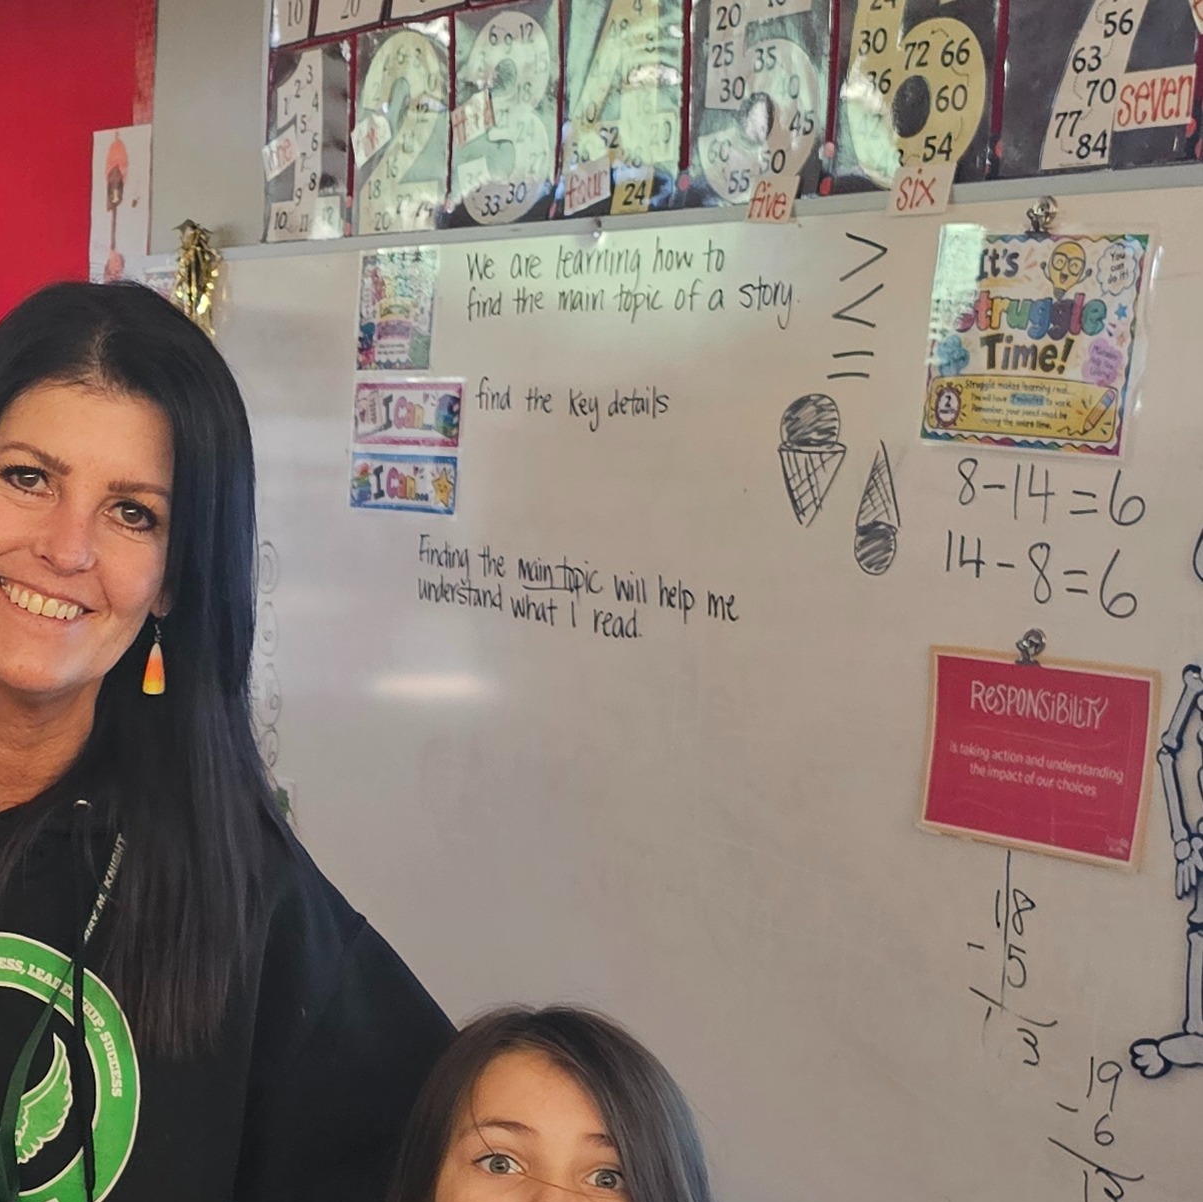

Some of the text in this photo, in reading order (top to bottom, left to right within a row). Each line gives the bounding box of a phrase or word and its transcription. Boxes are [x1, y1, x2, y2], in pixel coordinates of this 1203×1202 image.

[716, 3, 742, 30] 20
[1103, 8, 1133, 39] 56
[712, 41, 734, 68] 25
[858, 27, 887, 56] 30
[904, 41, 930, 70] 72
[941, 38, 970, 68] 66
[753, 46, 777, 73] 35
[1072, 45, 1102, 74] 63
[720, 76, 746, 103] 30
[935, 84, 968, 113] 60
[1086, 78, 1117, 107] 70
[1117, 75, 1193, 127] seven
[789, 111, 814, 135] 45
[1055, 110, 1082, 138] 77
[922, 132, 953, 162] 54
[1076, 130, 1107, 159] 84
[622, 180, 646, 206] 24
[728, 169, 751, 194] 55
[897, 168, 936, 211] six
[748, 181, 787, 220] five
[274, 212, 287, 230] 10
[467, 236, 725, 288] We are learning how to
[976, 249, 1019, 281] It's
[467, 286, 502, 321] find
[513, 286, 544, 315] the
[558, 288, 604, 312] main
[613, 283, 663, 323] topic
[675, 279, 703, 311] of
[708, 288, 724, 311] a
[980, 333, 1075, 375] Time!
[475, 376, 511, 410] find
[525, 386, 553, 413] the
[608, 386, 670, 419] details
[419, 534, 739, 624] Finding the main topic will help me
[418, 575, 503, 611] understand
[510, 594, 557, 626] what
[949, 741, 1124, 786] is taking action and understanding
[969, 763, 1097, 797] the impact of our choices
